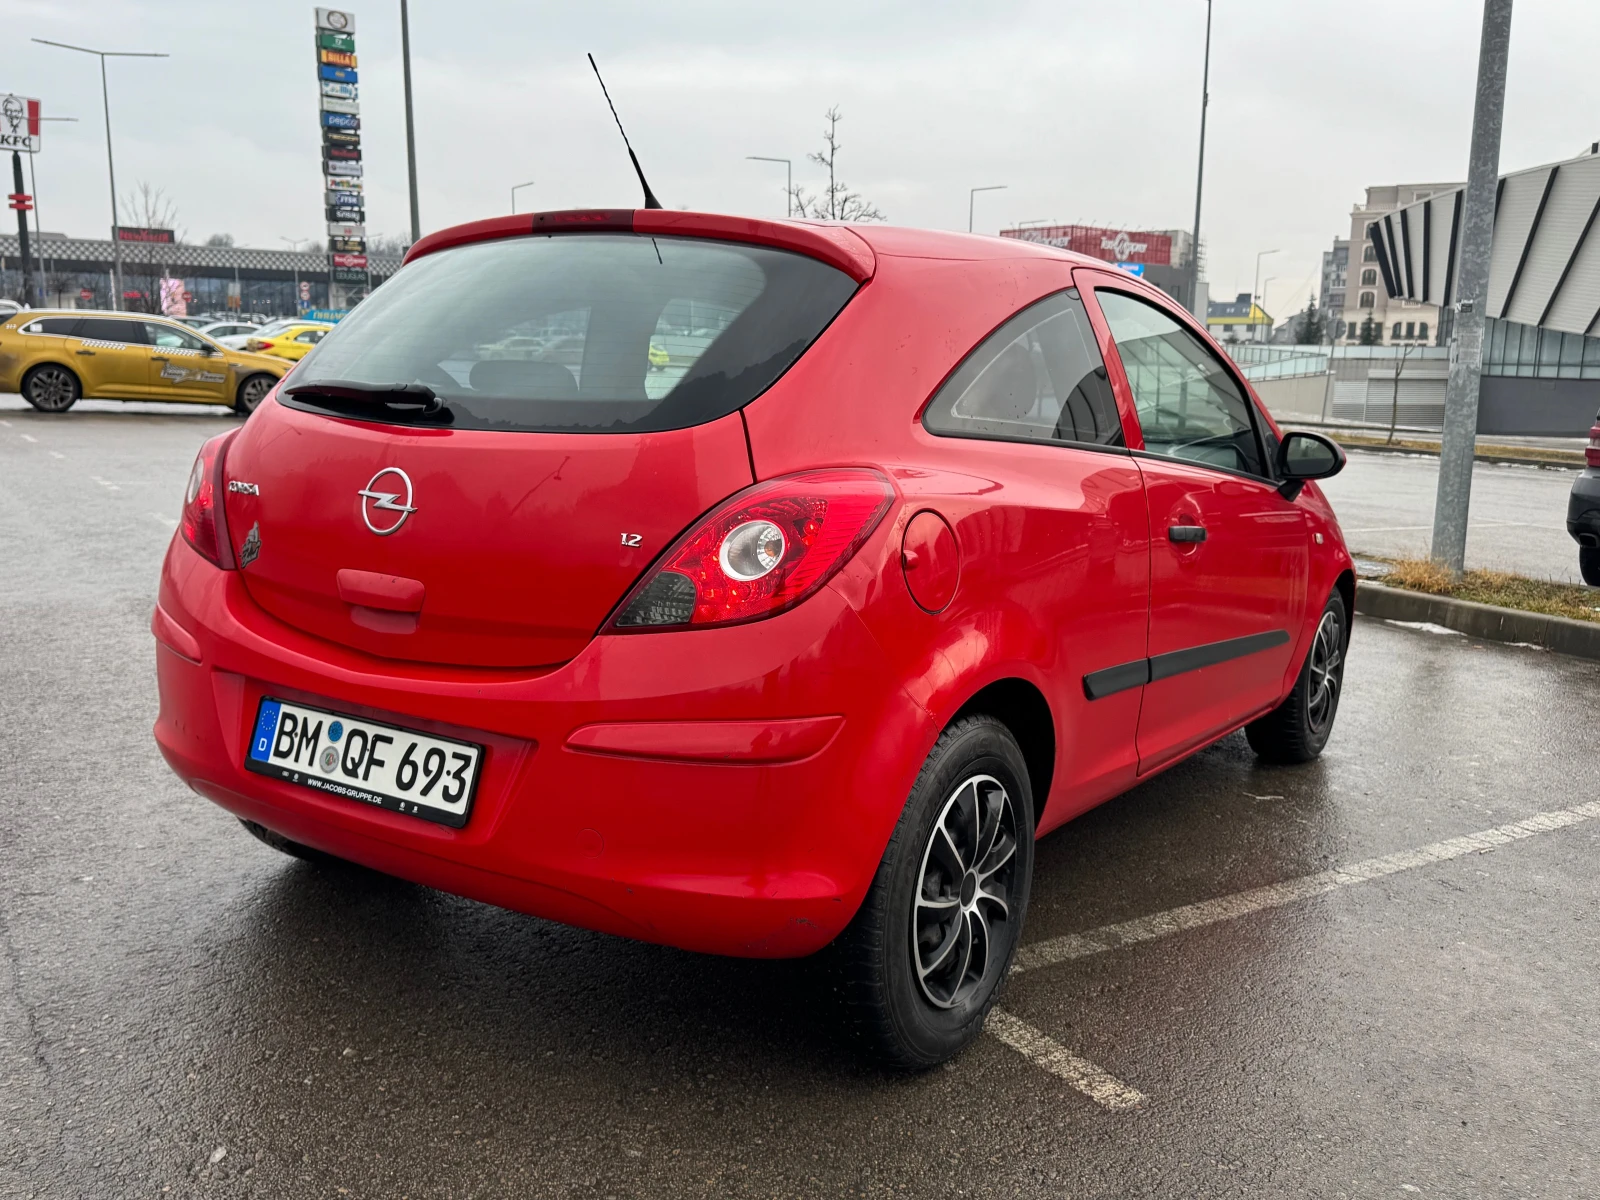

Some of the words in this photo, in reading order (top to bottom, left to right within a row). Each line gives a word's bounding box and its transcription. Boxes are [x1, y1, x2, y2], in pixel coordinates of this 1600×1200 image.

[0, 134, 33, 148] KFC
[257, 737, 268, 752] D
[272, 711, 324, 767] BM
[341, 728, 394, 782] QF
[395, 742, 472, 804] 693
[307, 778, 383, 805] WWW.JACOBS-GRUPPE.DE
